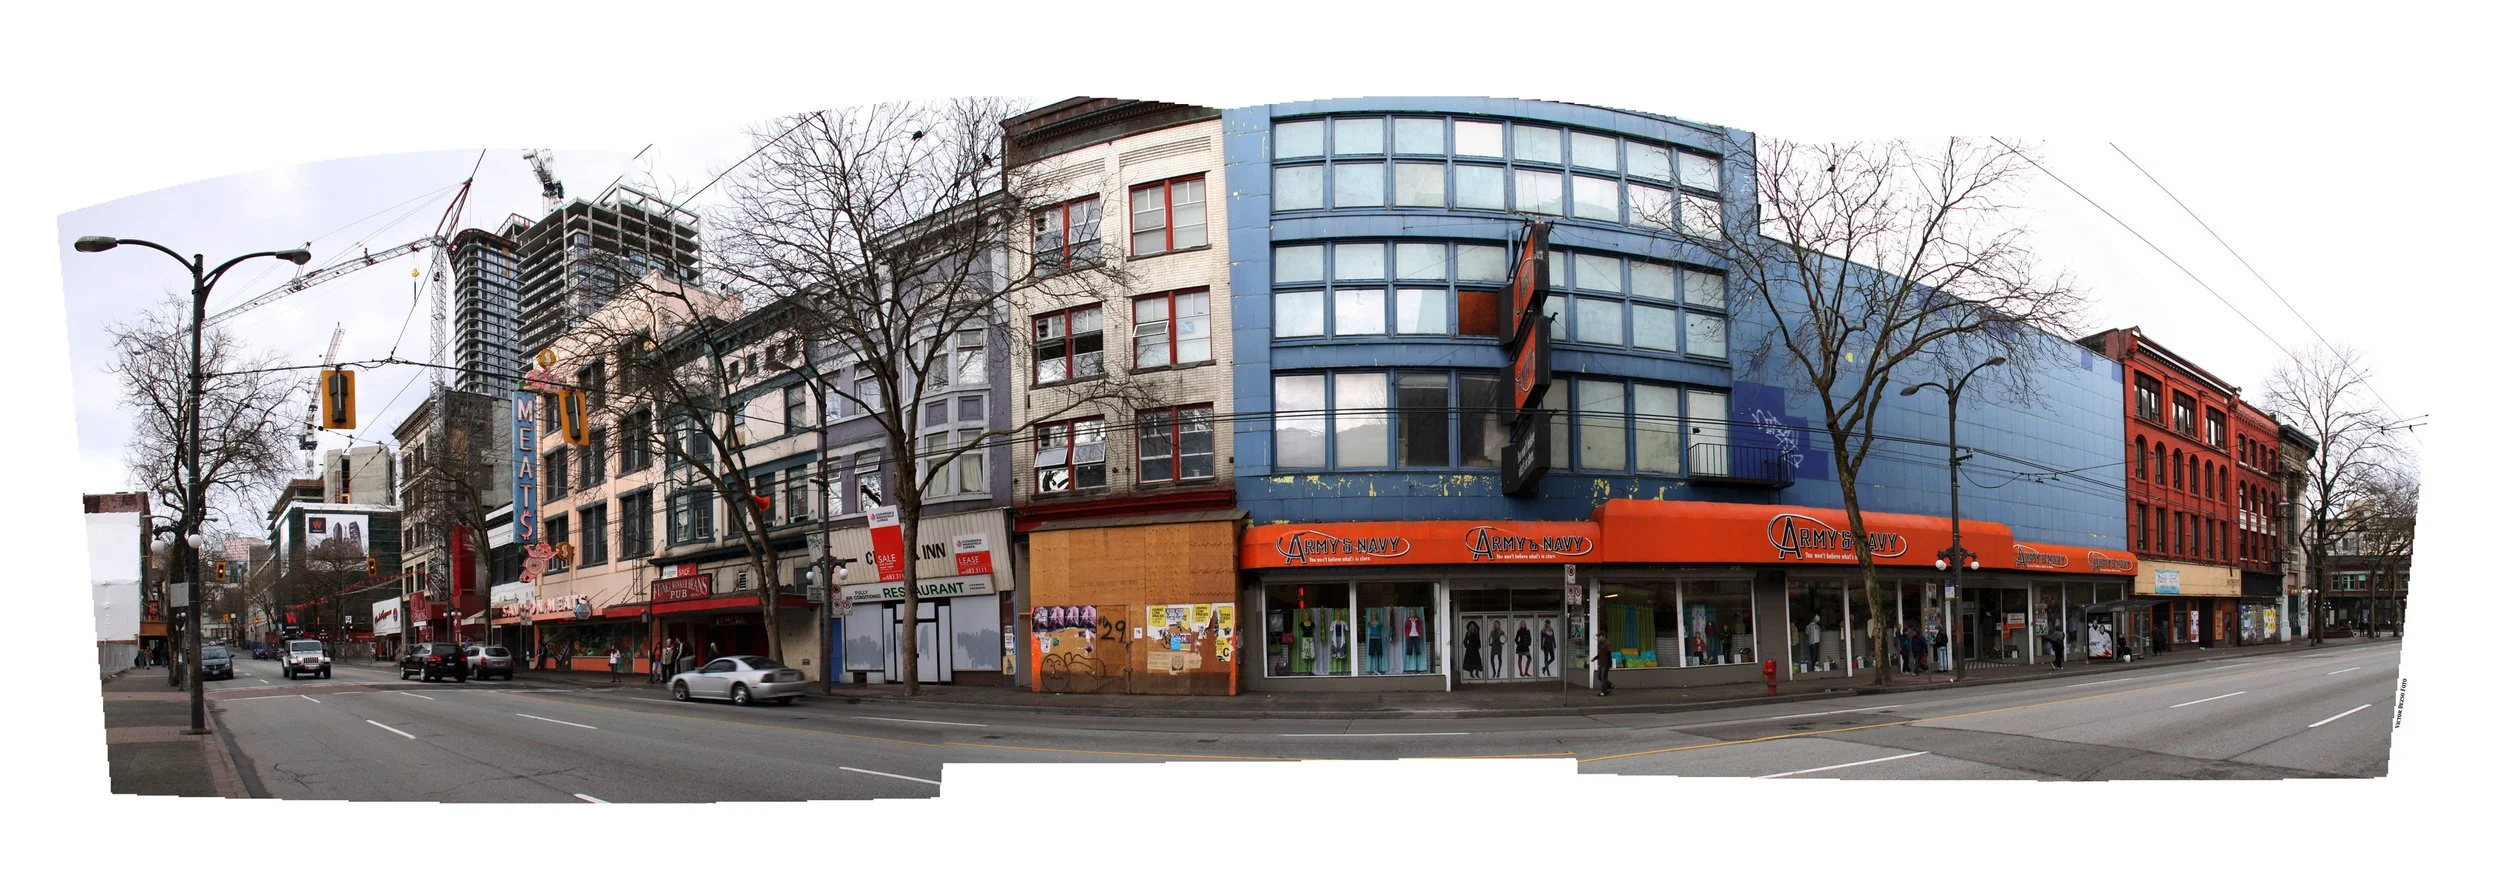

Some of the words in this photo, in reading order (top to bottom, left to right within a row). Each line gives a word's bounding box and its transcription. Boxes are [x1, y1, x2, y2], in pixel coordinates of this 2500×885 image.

[1473, 527, 1526, 560] ARMY
[1543, 536, 1583, 551] NAVY
[1779, 516, 1838, 560] ARMY
[1841, 530, 1852, 550] &
[1868, 531, 1897, 551] AVY
[922, 542, 946, 560] INN
[1286, 534, 1340, 564] ARMY
[1342, 539, 1352, 554] &
[1357, 536, 1400, 553] NAVY
[1826, 552, 1841, 560] believe
[878, 554, 896, 563] SALE
[958, 556, 980, 564] LEASE
[670, 589, 688, 599] PUB
[882, 582, 964, 599] RESAURANT
